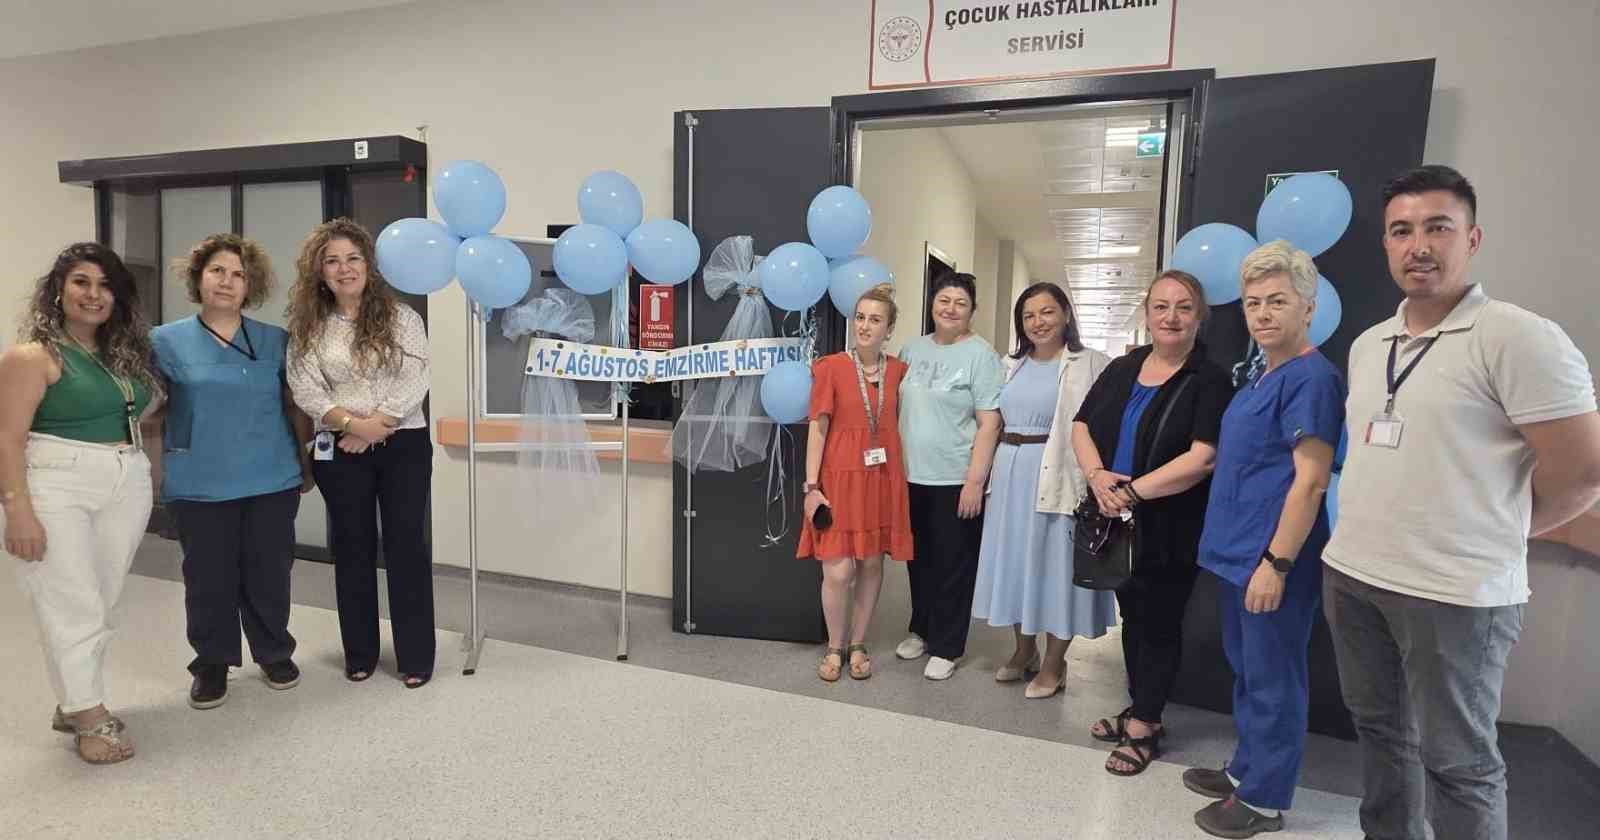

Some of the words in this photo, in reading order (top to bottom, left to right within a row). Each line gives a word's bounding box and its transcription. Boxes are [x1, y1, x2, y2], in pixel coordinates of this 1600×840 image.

[945, 5, 1010, 30] ÇOCUK
[1007, 28, 1084, 54] SERVİSİ
[536, 348, 561, 373] 1-7
[565, 348, 649, 378] AĞUSTOS
[654, 349, 729, 378] EMZİRME
